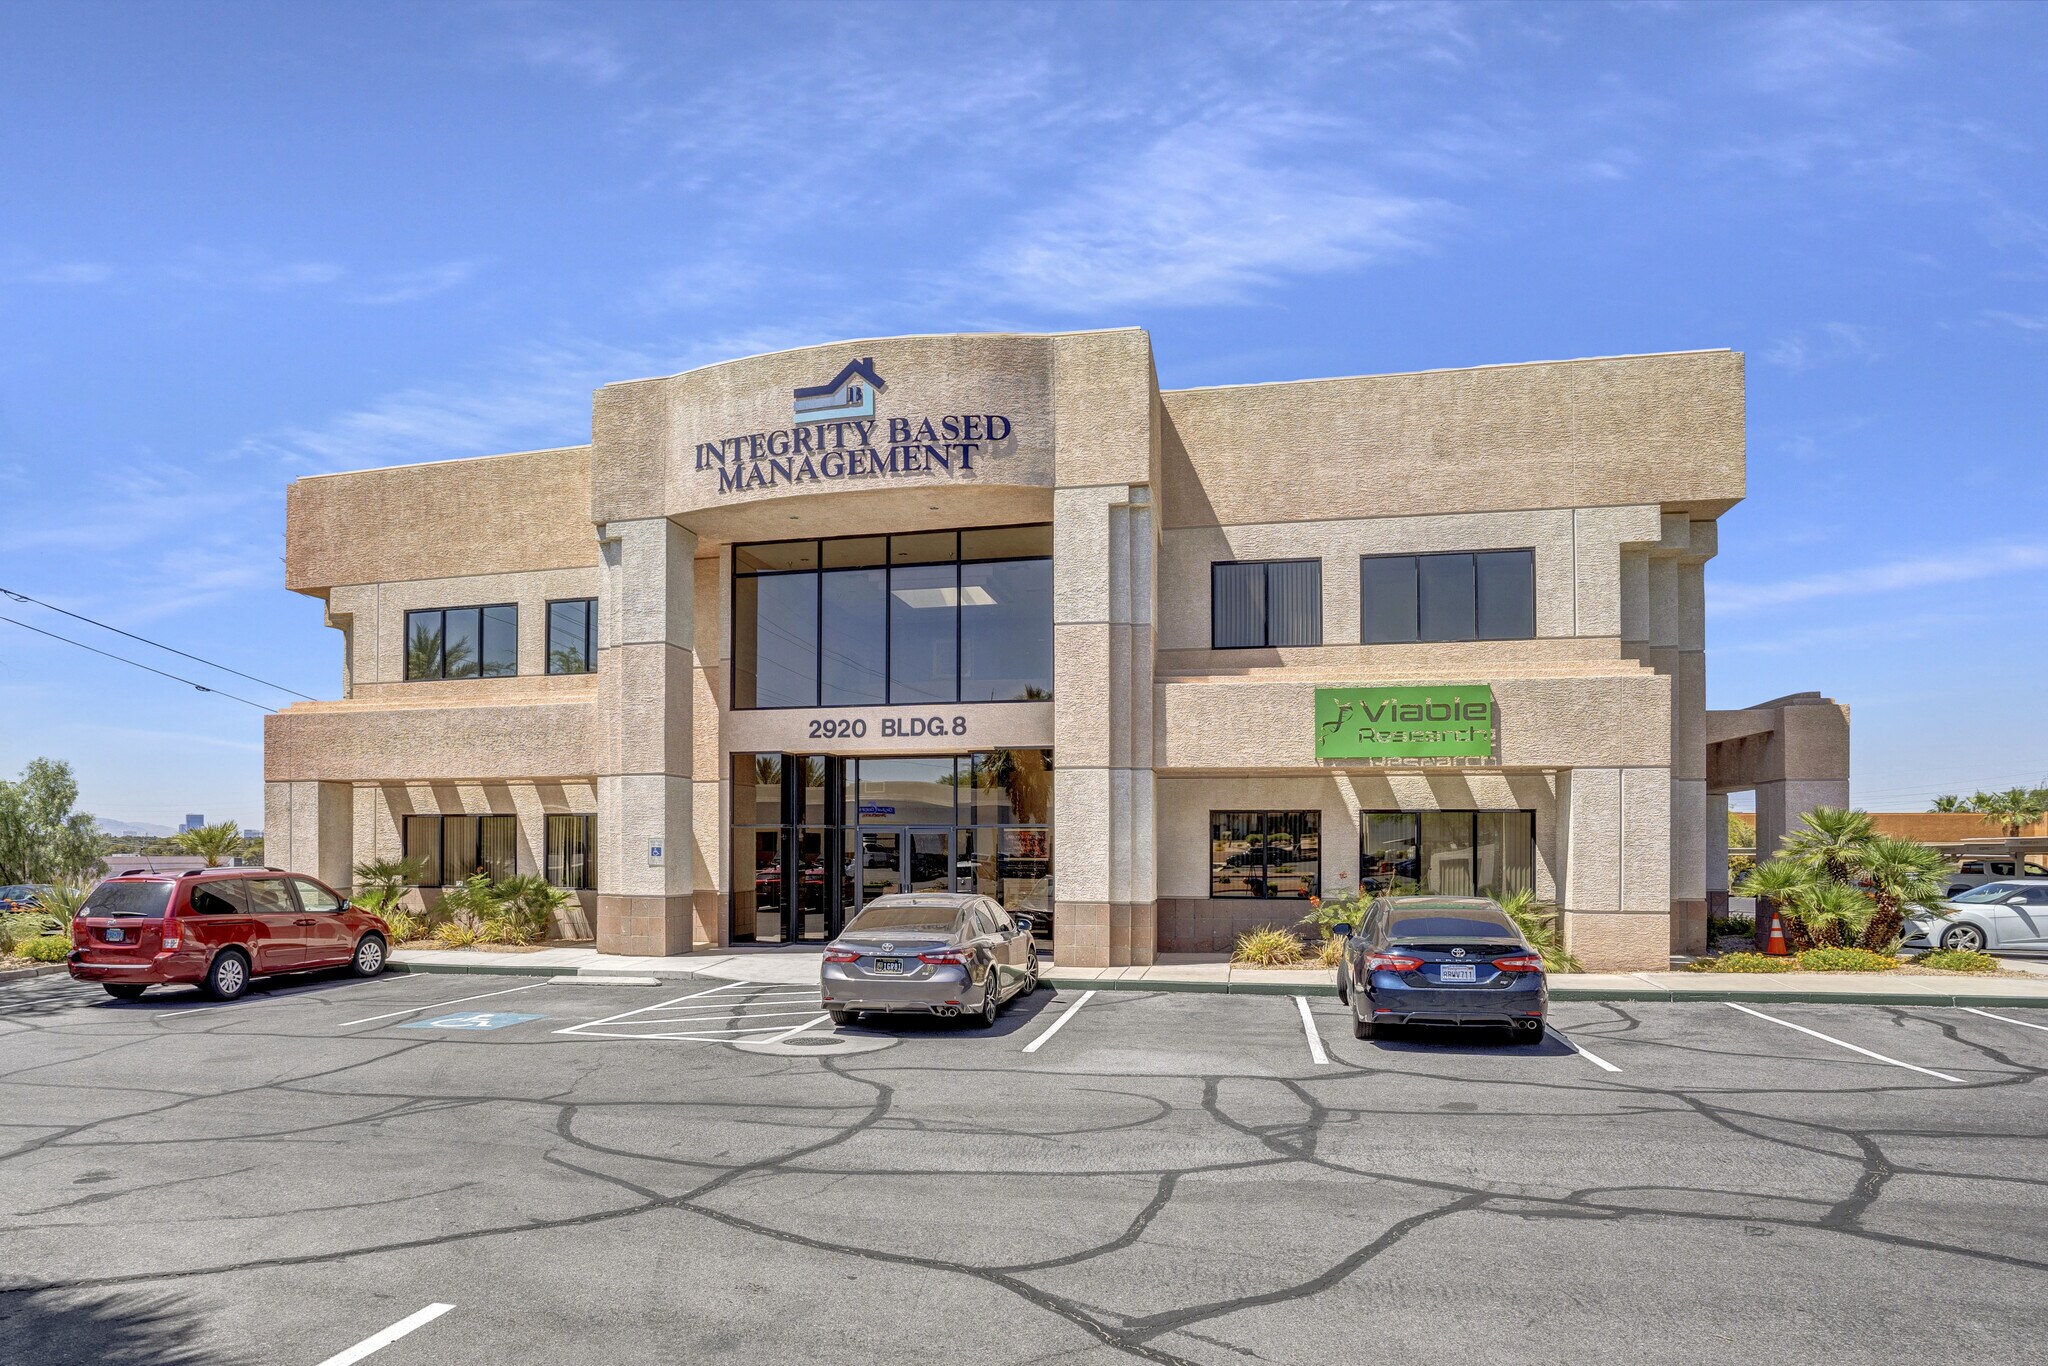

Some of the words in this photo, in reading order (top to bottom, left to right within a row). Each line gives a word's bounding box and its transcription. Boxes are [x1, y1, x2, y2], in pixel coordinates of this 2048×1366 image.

[695, 419, 876, 471] INTEGRITY
[888, 415, 1011, 443] BASED
[718, 443, 979, 493] MANAGEMENT
[809, 719, 867, 739] 2920
[1358, 726, 1488, 743] Research
